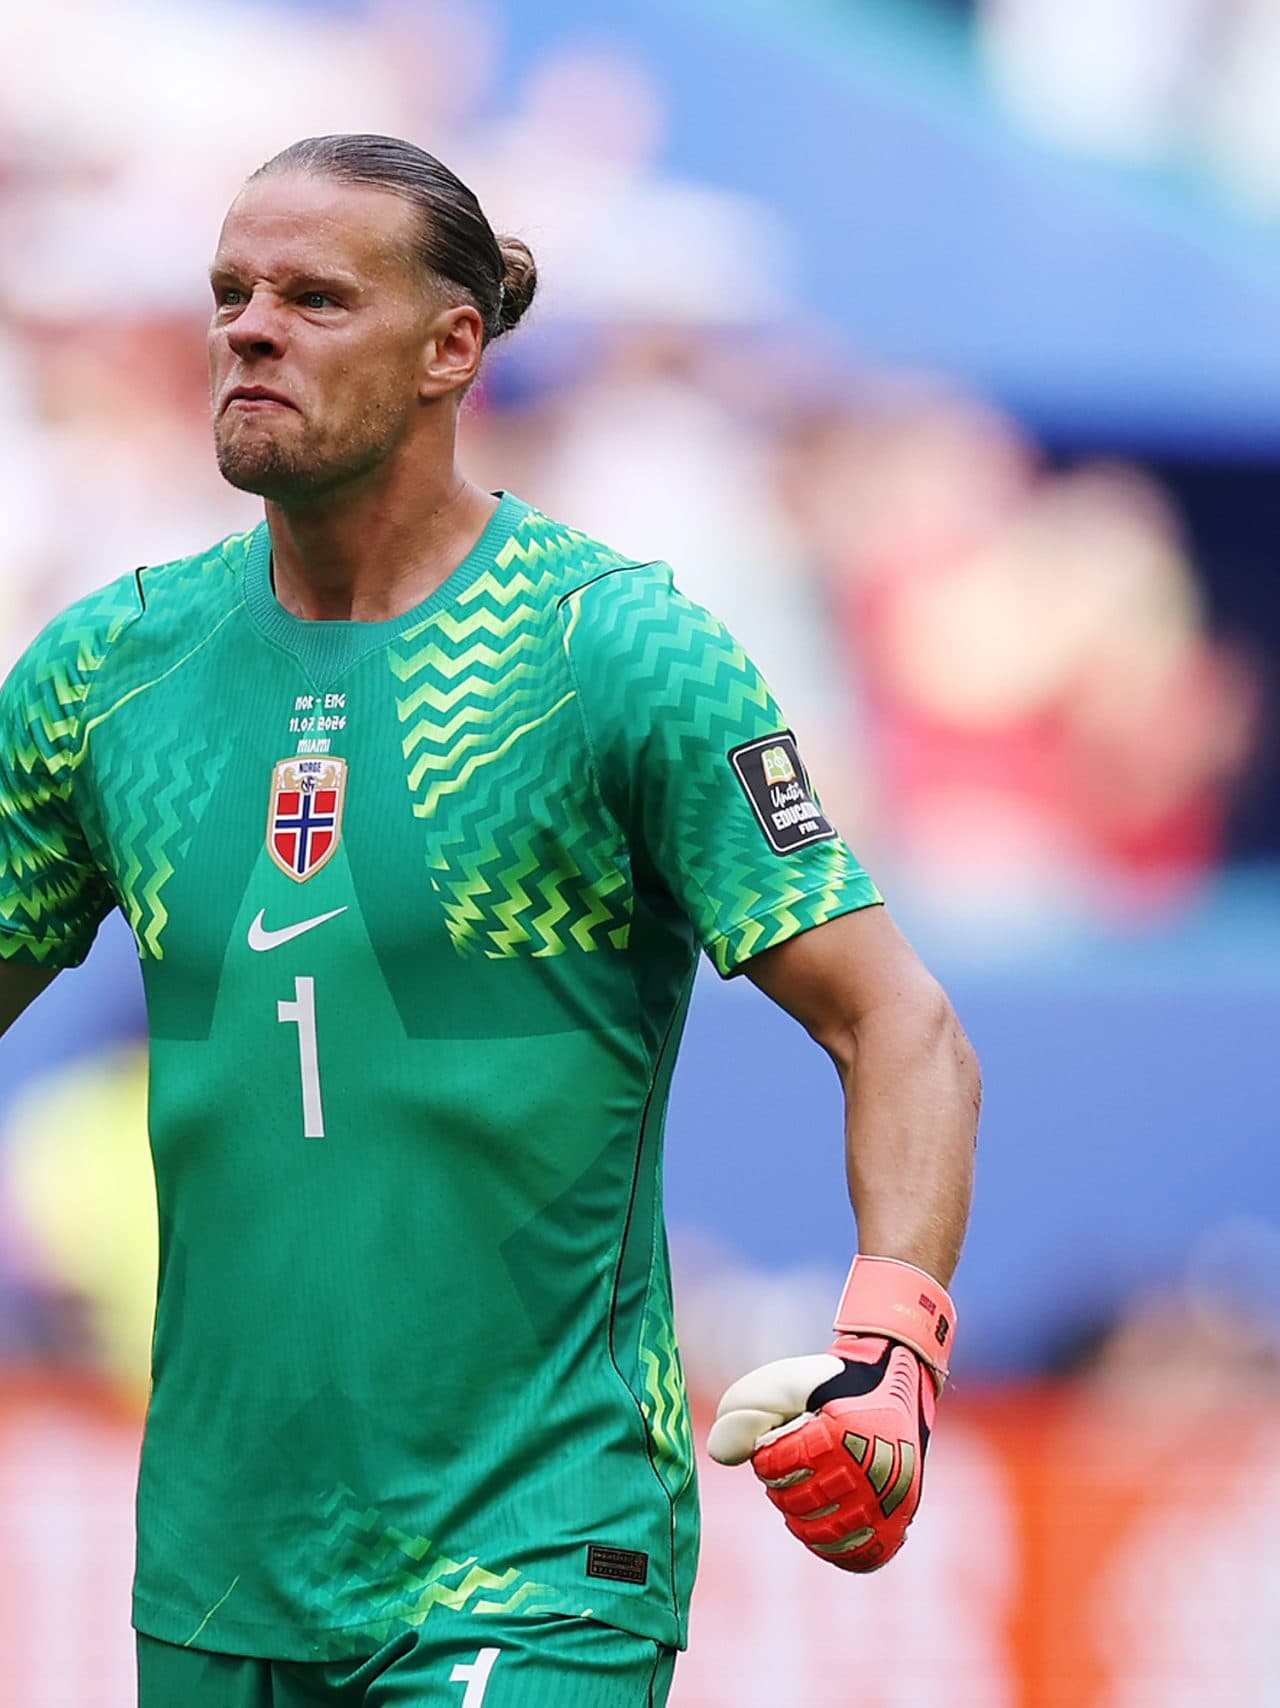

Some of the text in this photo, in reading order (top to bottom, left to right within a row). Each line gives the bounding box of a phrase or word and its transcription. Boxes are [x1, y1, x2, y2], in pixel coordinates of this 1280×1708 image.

[296, 696, 313, 710] NOR
[325, 694, 346, 708] ENG
[297, 739, 331, 752] MIAMI
[299, 762, 322, 773] NORGE
[277, 976, 325, 1138] 1
